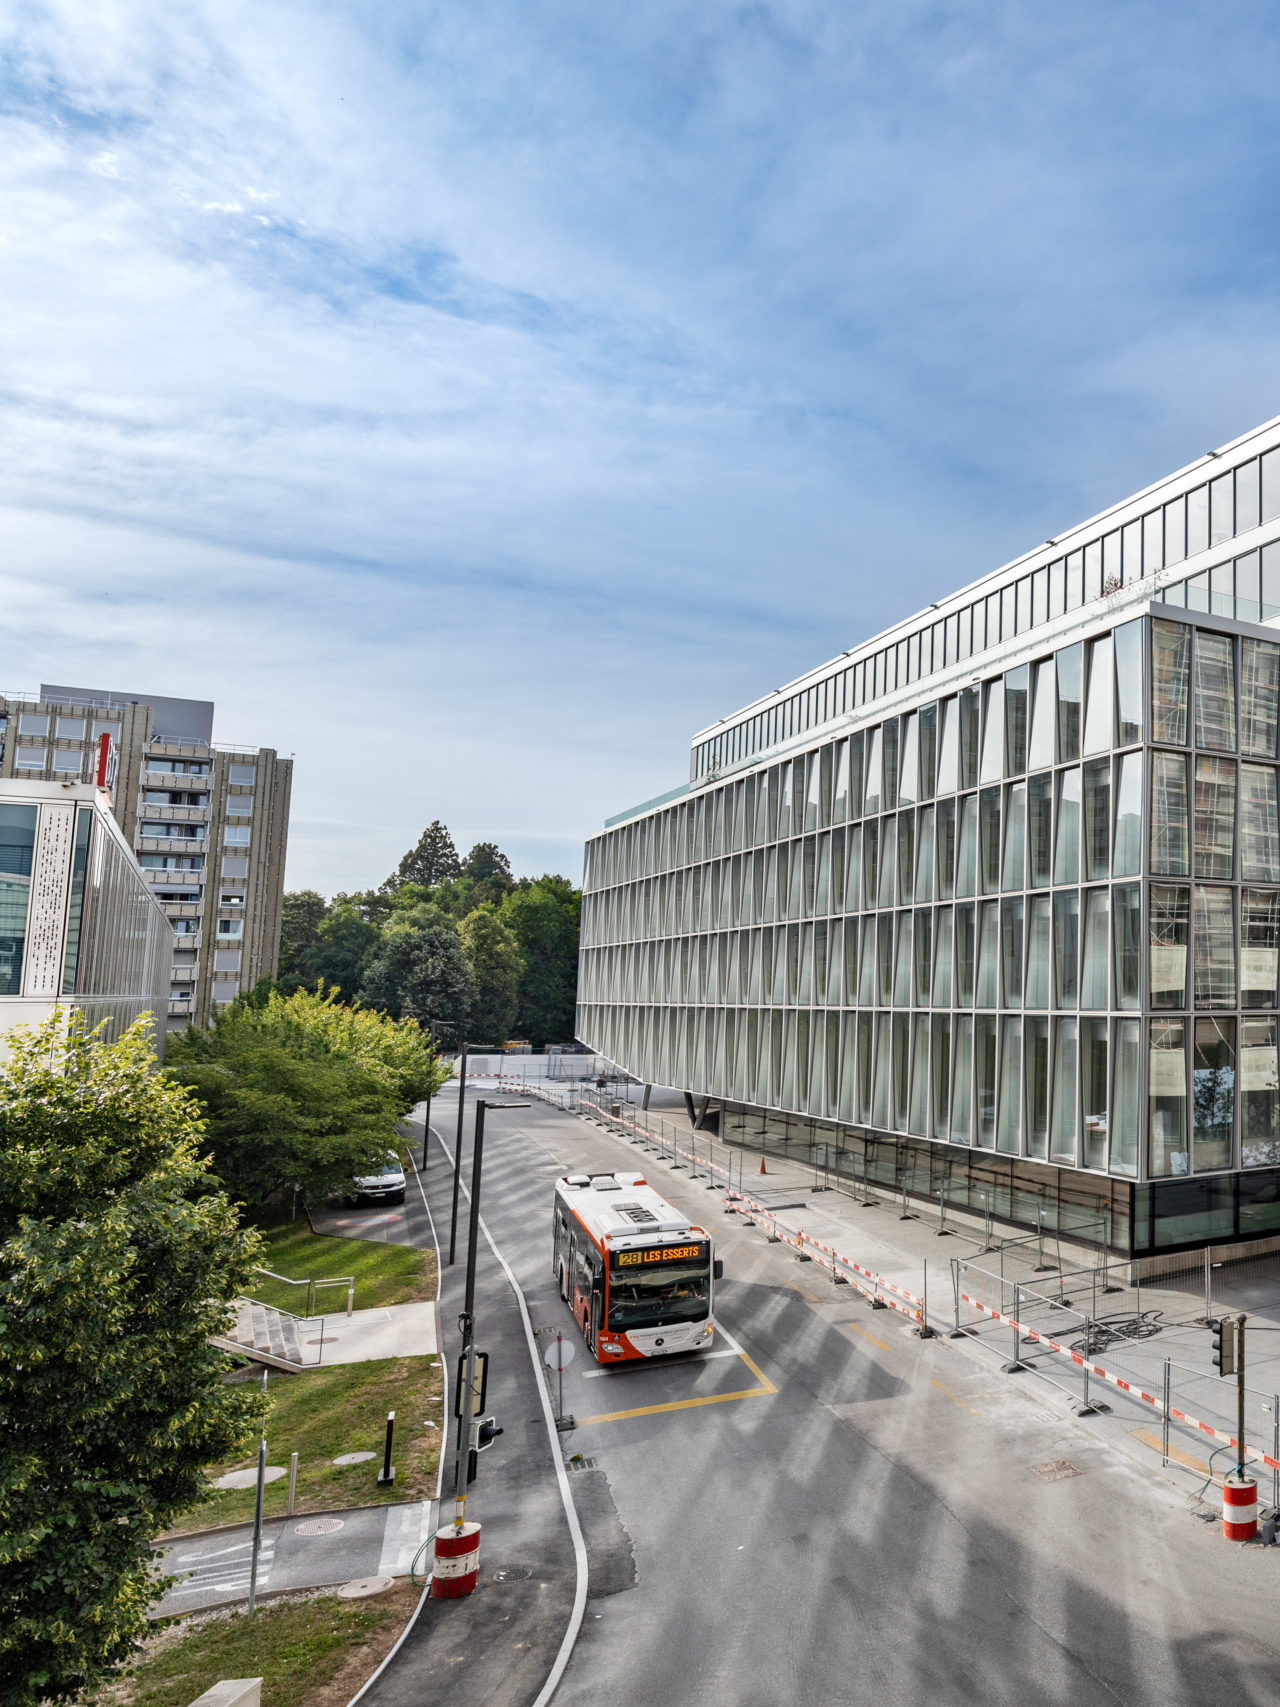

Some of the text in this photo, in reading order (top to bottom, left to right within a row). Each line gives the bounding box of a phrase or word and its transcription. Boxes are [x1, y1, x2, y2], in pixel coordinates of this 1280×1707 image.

[623, 1246, 699, 1264] 28 LES ESSERTS
